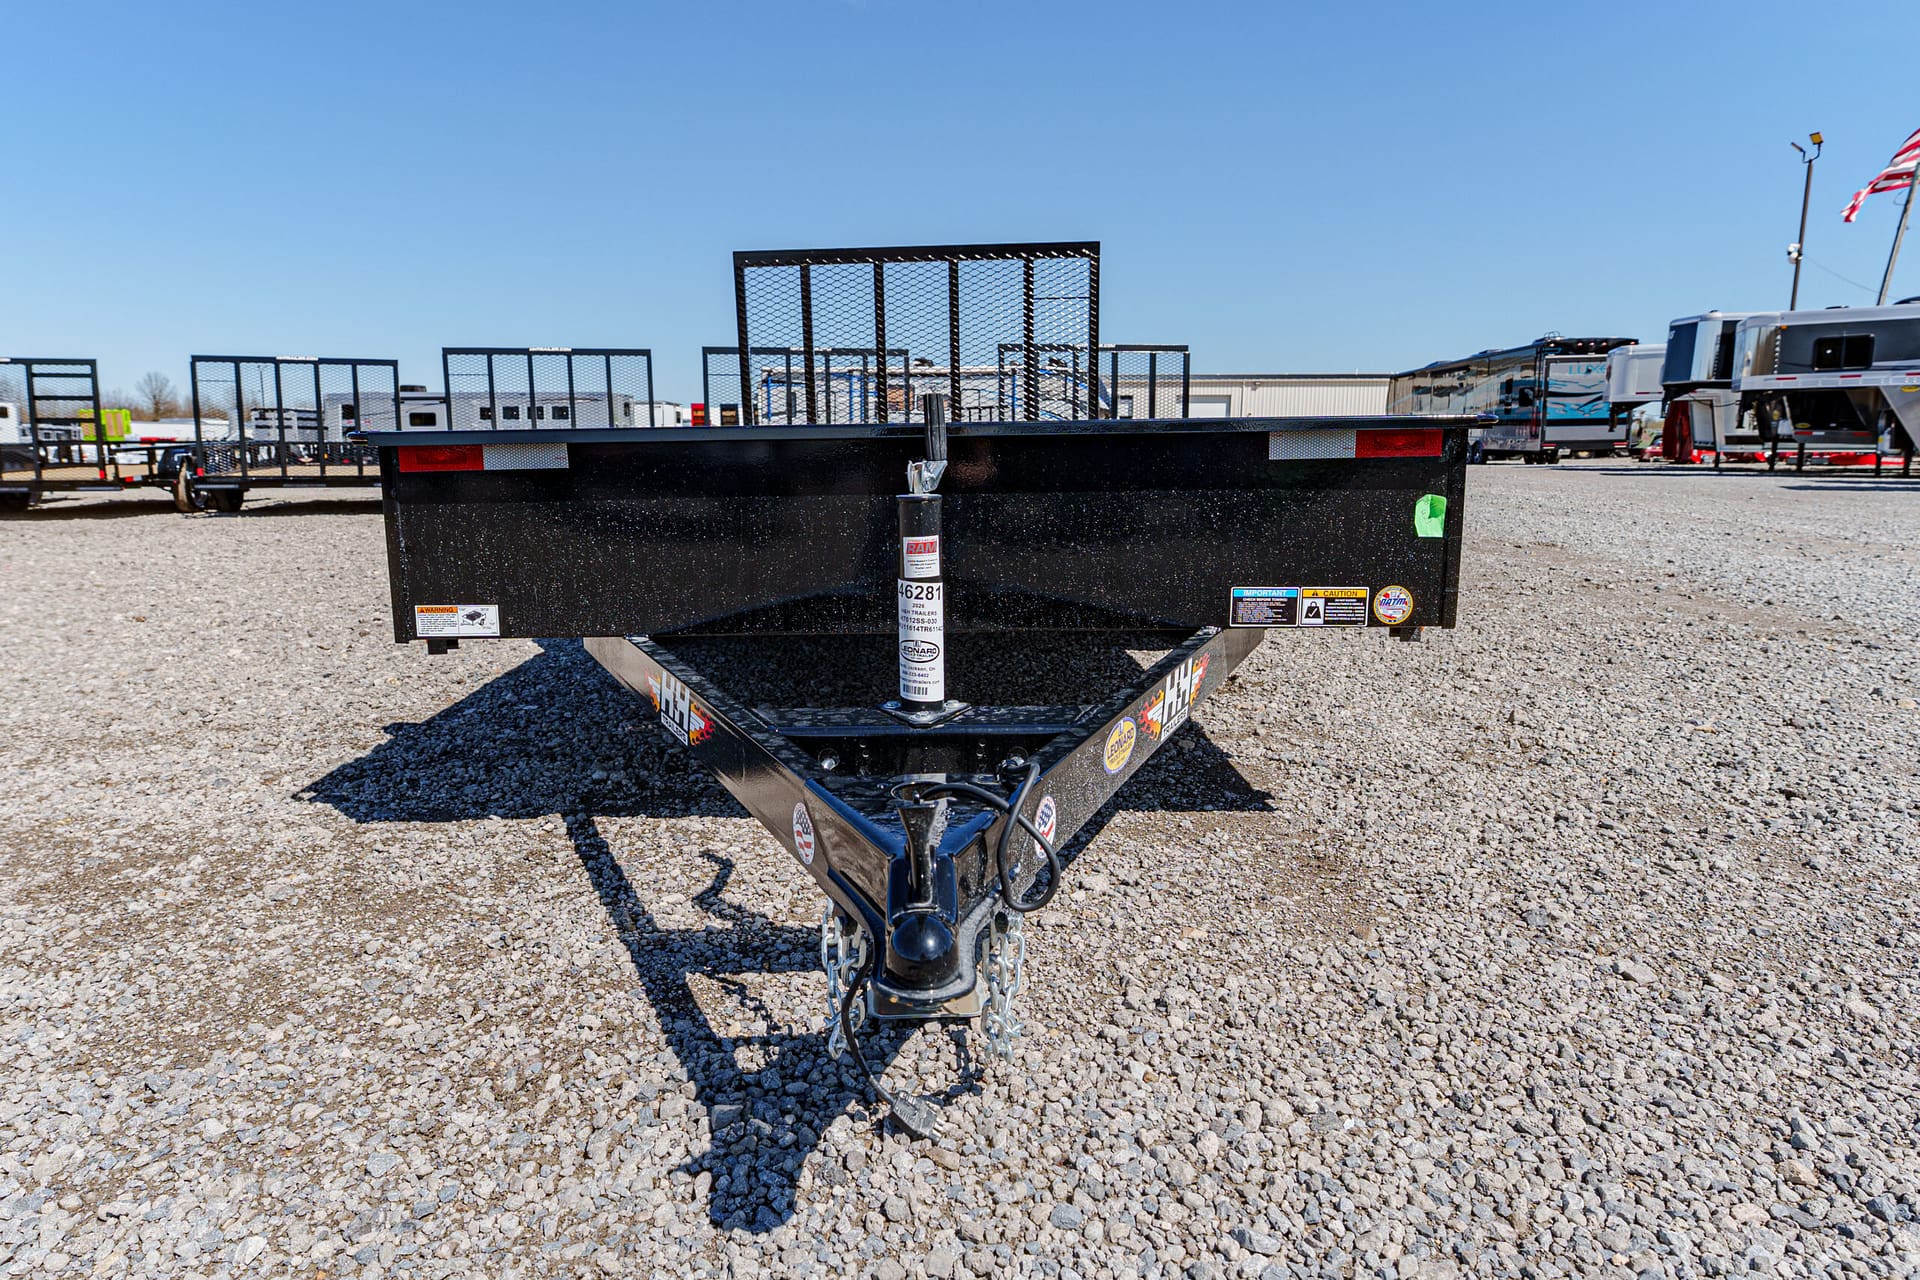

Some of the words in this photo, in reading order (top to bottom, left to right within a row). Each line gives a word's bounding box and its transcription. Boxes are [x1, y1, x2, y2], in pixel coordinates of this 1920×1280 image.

[907, 541, 937, 554] RAM
[899, 583, 941, 600] 46281
[901, 645, 937, 654] LEONARD
[1108, 727, 1134, 760] LEONARD
